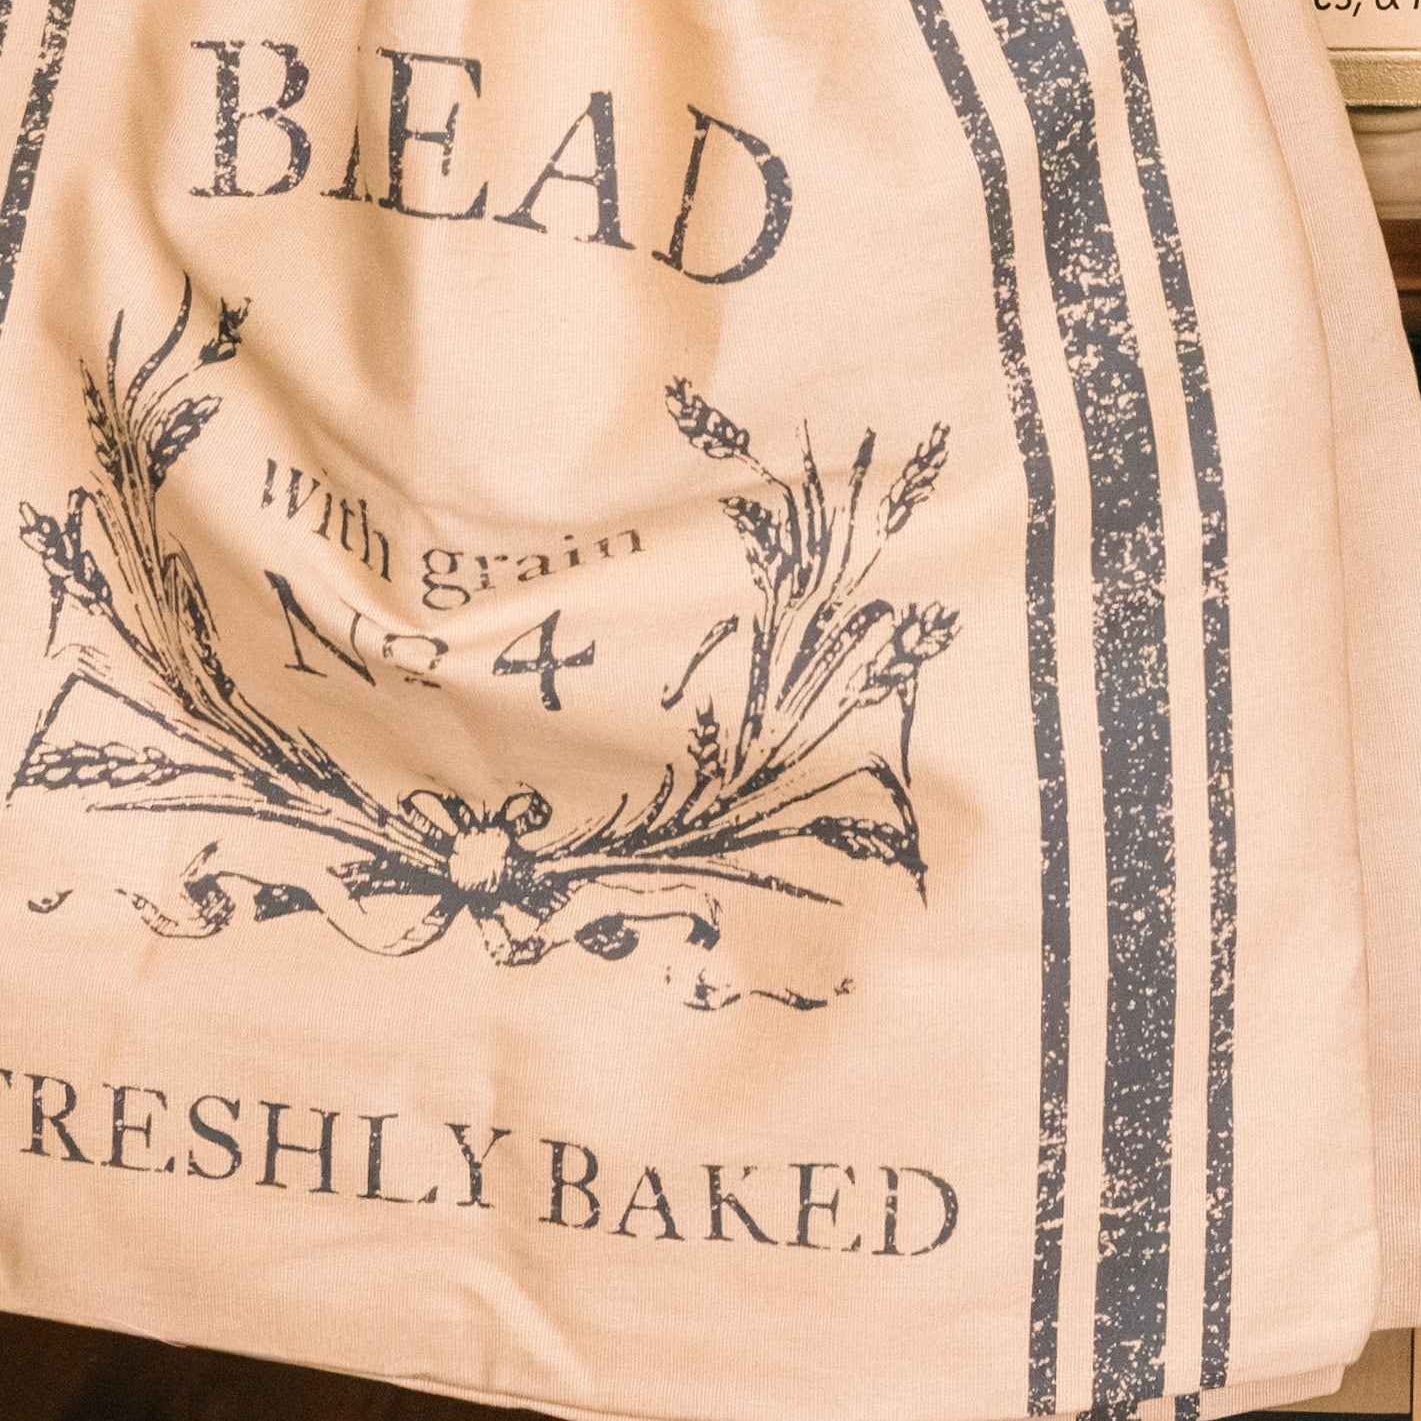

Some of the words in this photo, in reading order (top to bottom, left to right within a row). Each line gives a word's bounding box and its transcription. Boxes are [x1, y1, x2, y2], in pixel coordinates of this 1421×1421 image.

[259, 457, 392, 583] With
[422, 527, 646, 611] grain
[492, 609, 596, 711] 4
[0, 1069, 511, 1209] RESHLY
[539, 1138, 959, 1257] BAKED
